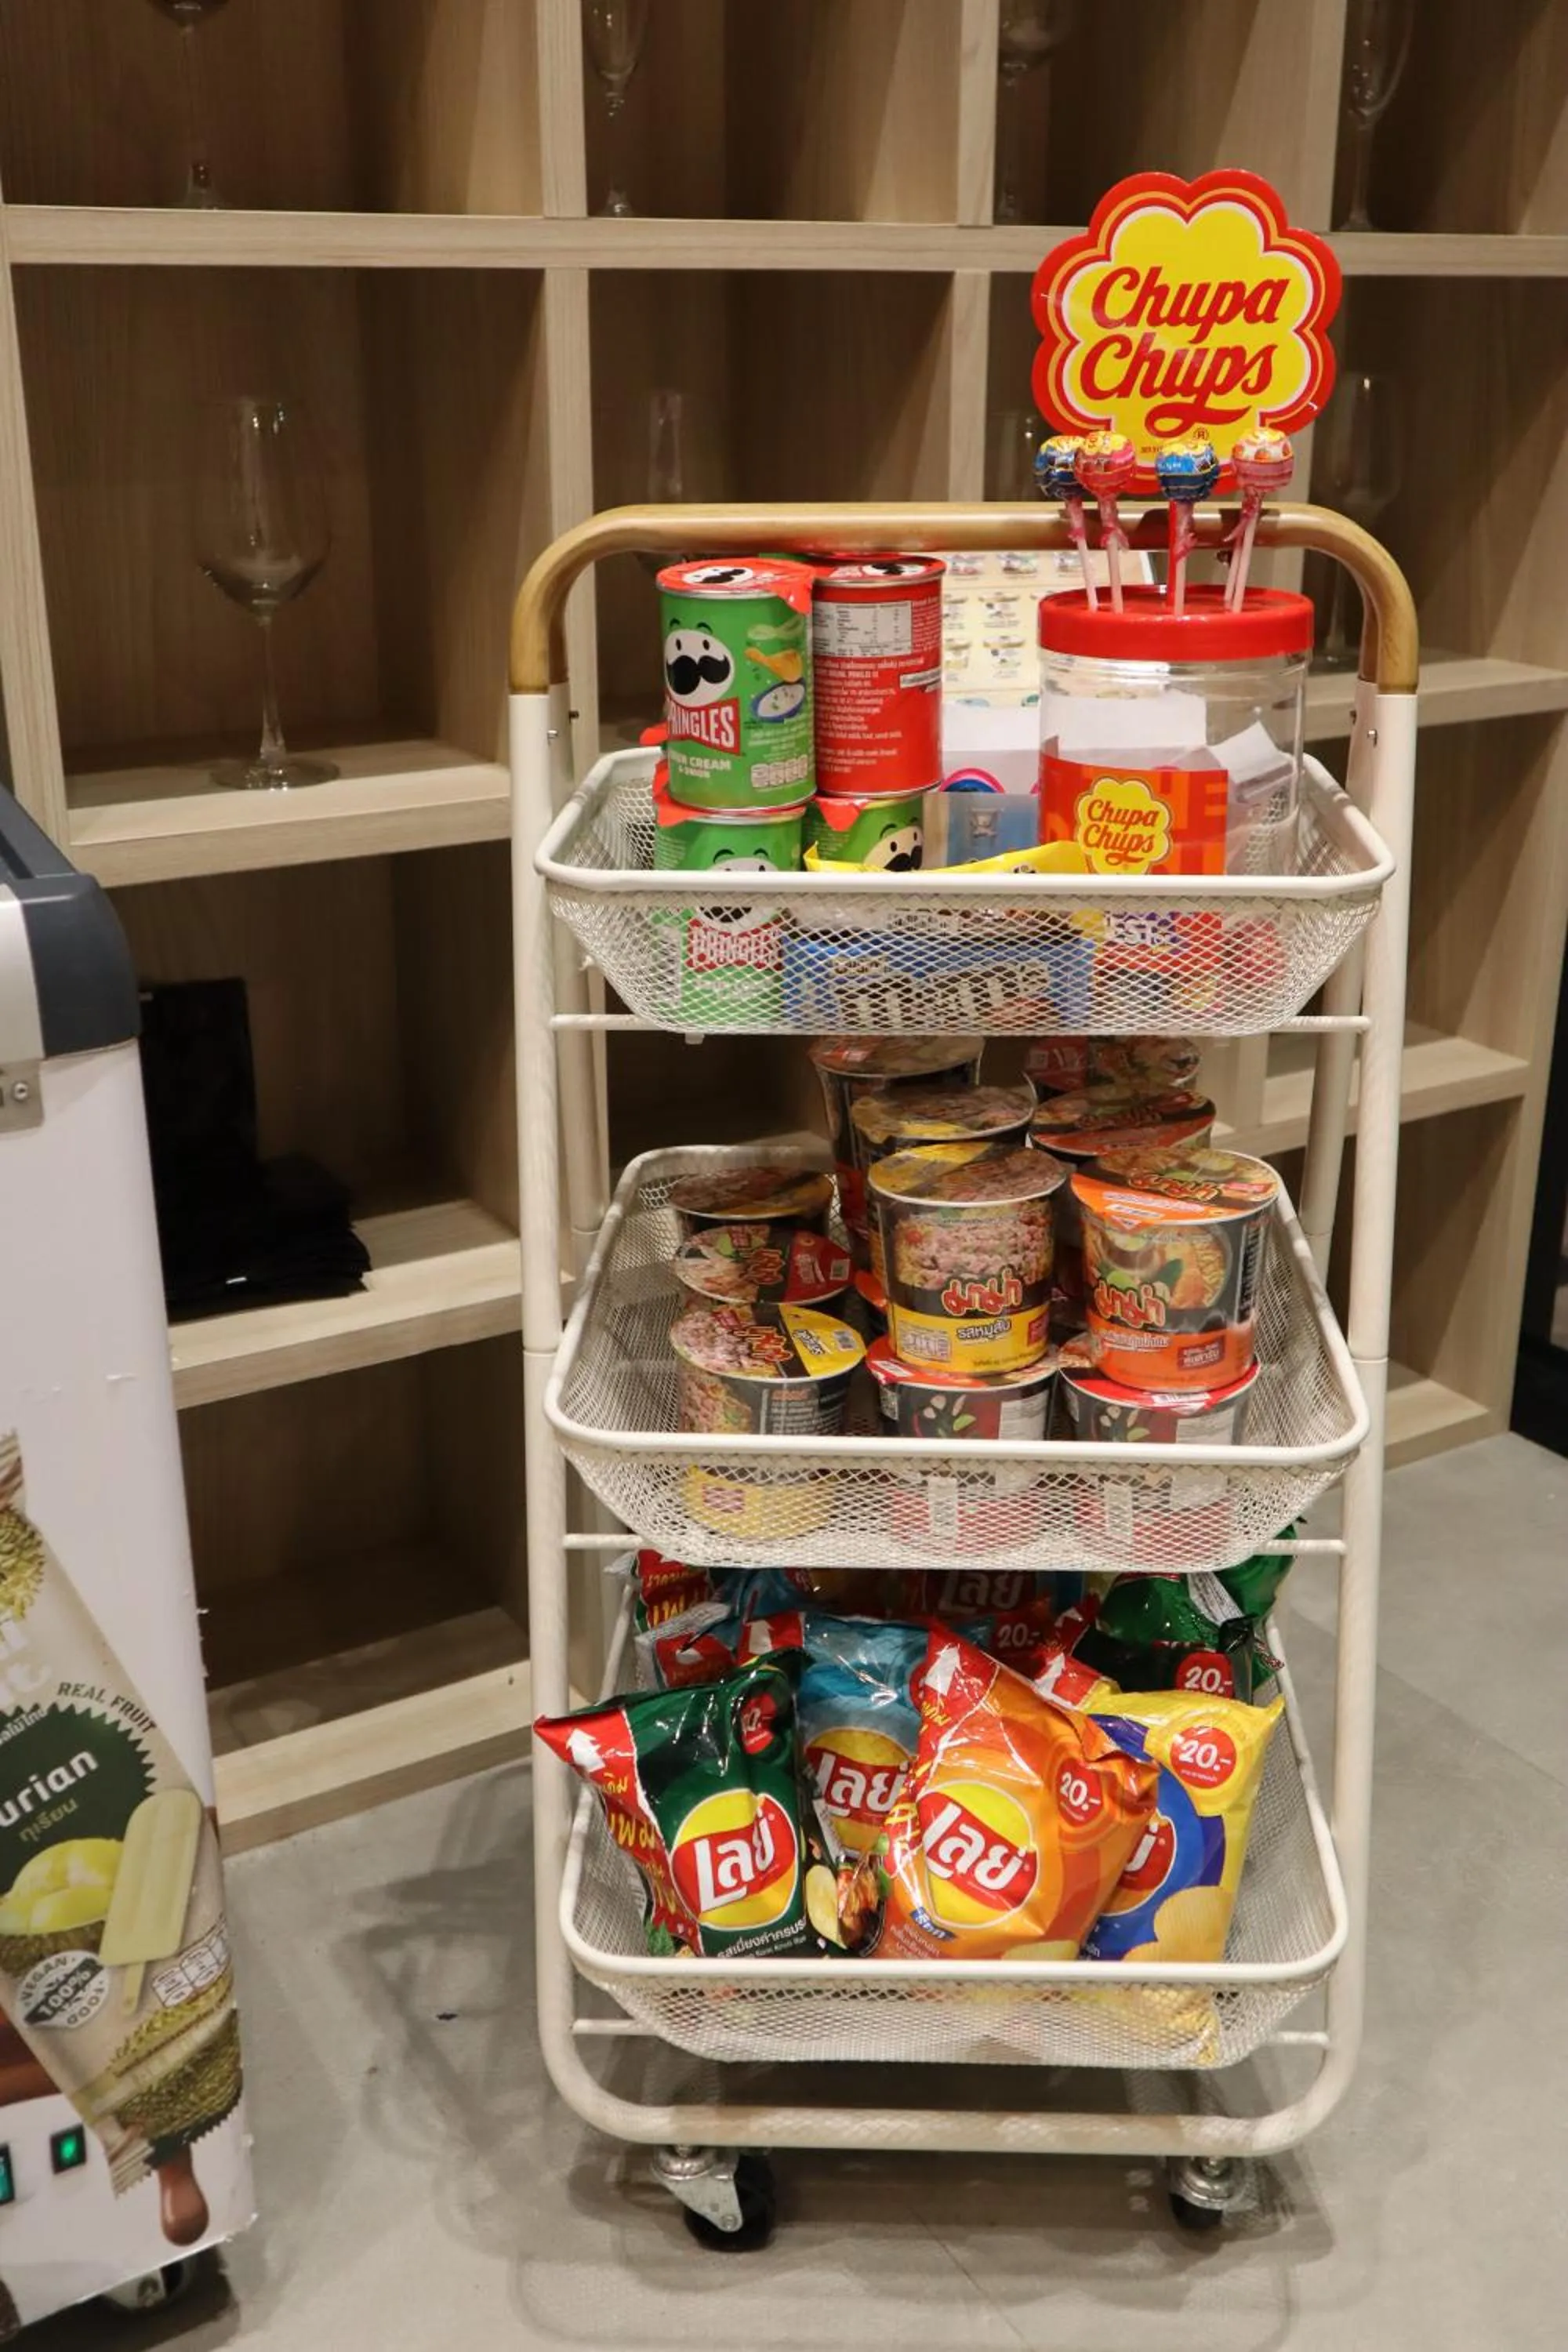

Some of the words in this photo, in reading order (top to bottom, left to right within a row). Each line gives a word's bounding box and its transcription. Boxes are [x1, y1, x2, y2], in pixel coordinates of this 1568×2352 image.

[1091, 266, 1290, 343] Chupa
[1080, 332, 1278, 438] Chups
[689, 757, 732, 771] CREAM
[1087, 799, 1160, 831] Chupa
[1083, 823, 1155, 866] Chups
[938, 1571, 1025, 1614] เลย
[1185, 1665, 1233, 1694] 20.-
[57, 1682, 106, 1704] REAL
[111, 1695, 157, 1733] FRUIT
[1178, 1739, 1232, 1772] 20.-
[0, 1751, 98, 1828] urian
[1059, 1772, 1101, 1811] 20.-
[694, 1806, 775, 1914] เลย์
[922, 1802, 1027, 1891] เลย์
[20, 1957, 67, 2002] VEGAN
[38, 1970, 92, 2017] 100%
